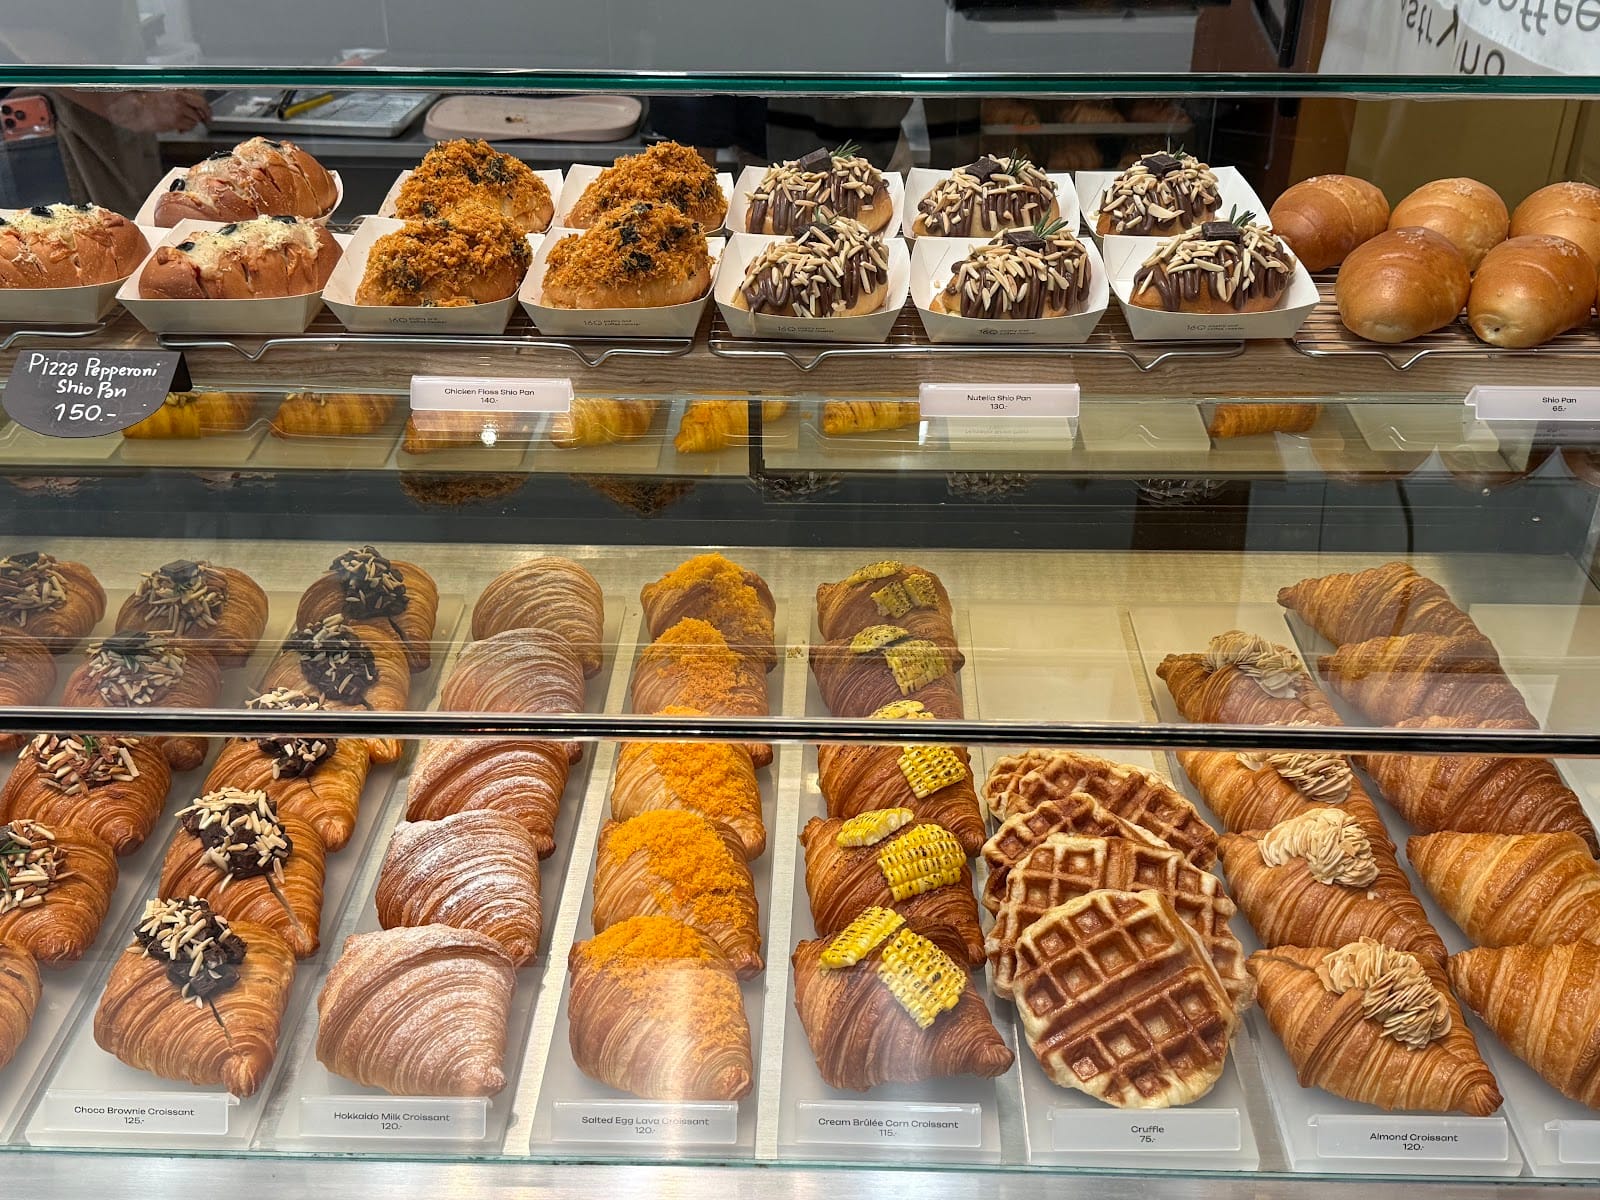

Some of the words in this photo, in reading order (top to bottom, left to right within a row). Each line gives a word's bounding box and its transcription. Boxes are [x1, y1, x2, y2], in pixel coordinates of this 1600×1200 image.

[28, 353, 79, 376] Pizza
[85, 357, 161, 381] Pepperoni
[56, 379, 94, 396] Shio
[97, 381, 127, 399] Pan
[445, 388, 476, 396] Chicken
[478, 388, 499, 396] Floss
[967, 394, 996, 402] Nutella
[1542, 396, 1560, 404] Shio
[54, 403, 117, 422] 150.-
[74, 1106, 105, 1115] Choco
[107, 1107, 146, 1116] Brownie
[148, 1107, 195, 1116] Croissant
[334, 1112, 379, 1121] Hokkaido
[381, 1112, 401, 1121] Milk
[402, 1113, 451, 1122] Croissant
[581, 1116, 613, 1125] Salted
[615, 1116, 634, 1126] Egg
[635, 1117, 660, 1125] Lava
[661, 1118, 710, 1126] Croissant
[818, 1118, 851, 1126] Cream
[853, 1118, 883, 1127] Brûlée
[885, 1120, 909, 1128] Corn
[911, 1120, 959, 1129] Croissant
[1130, 1125, 1165, 1134] Cruffle
[1369, 1132, 1408, 1141] Almond
[1409, 1133, 1459, 1142] Croissant
